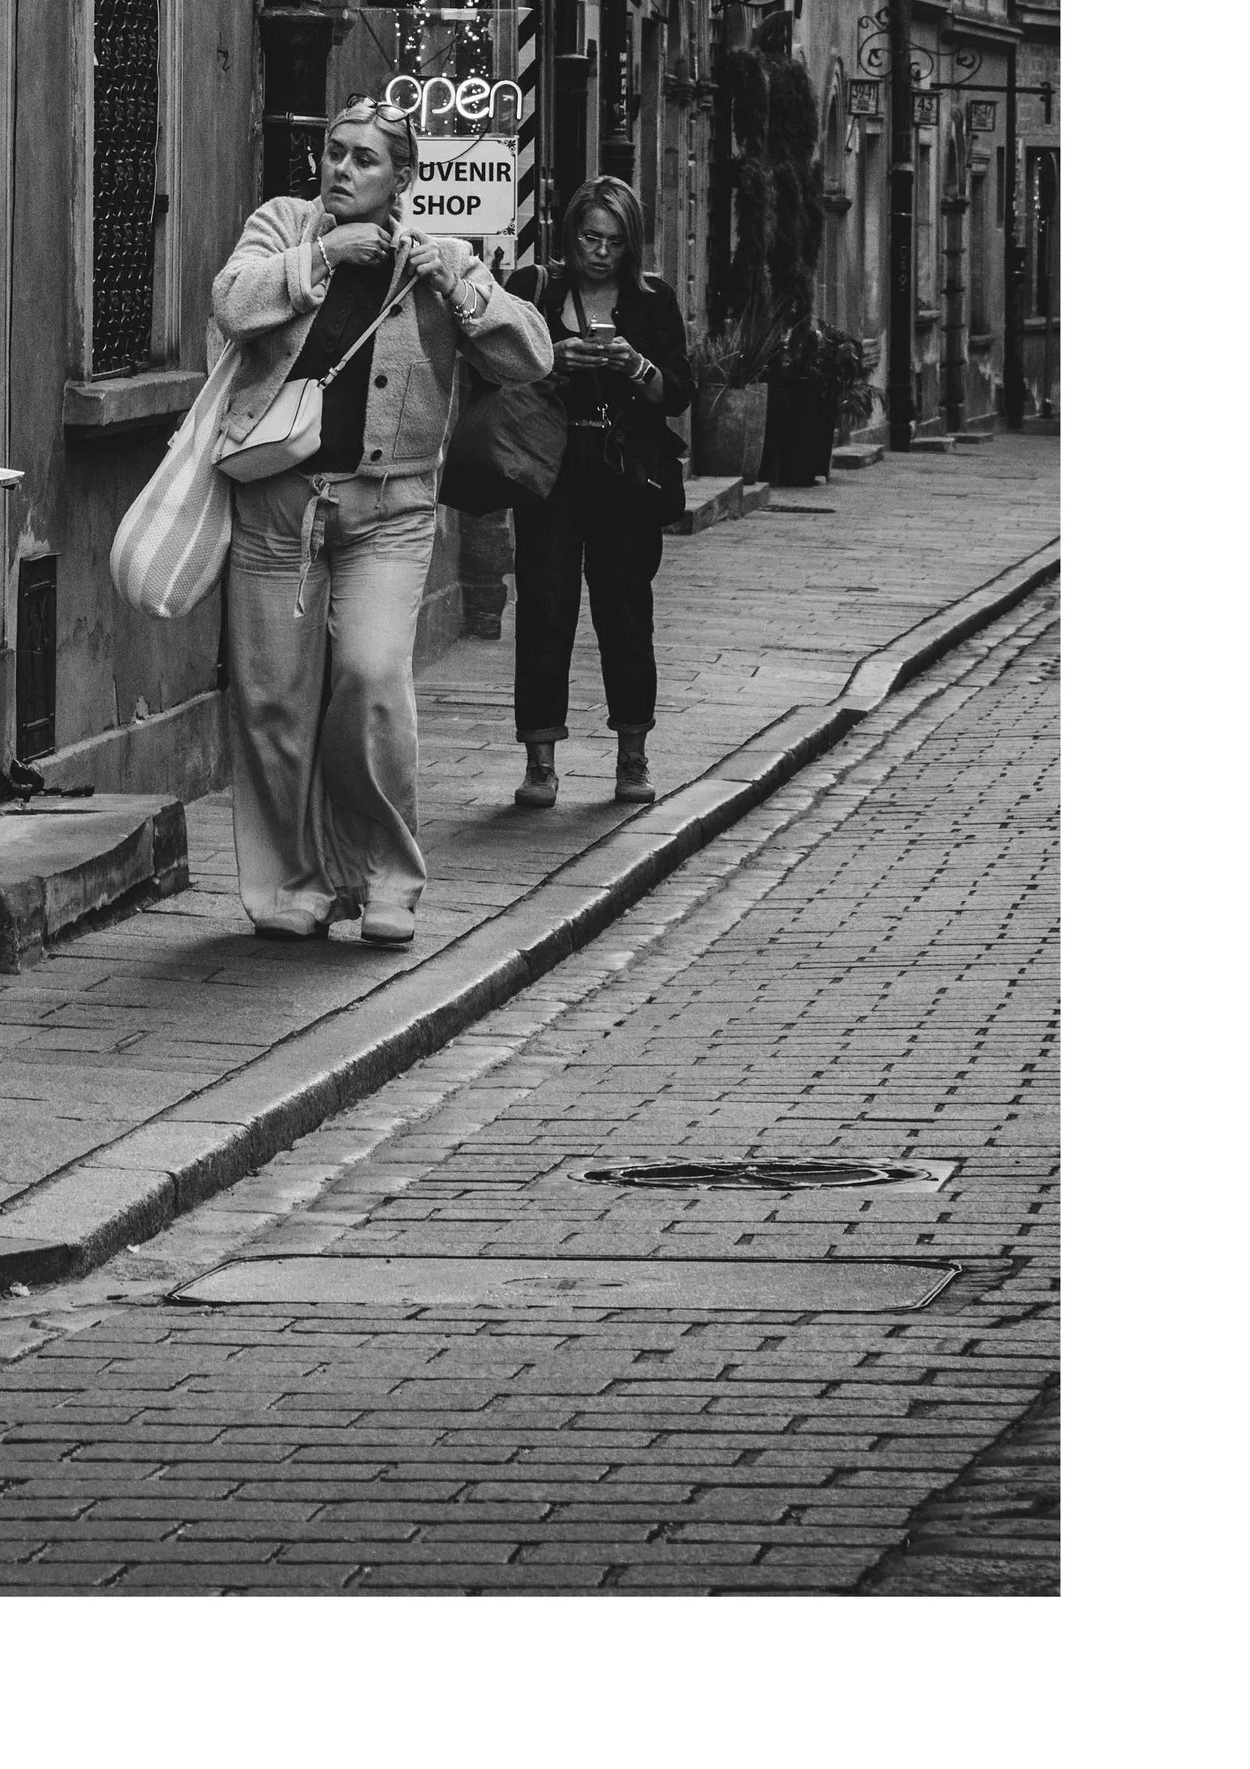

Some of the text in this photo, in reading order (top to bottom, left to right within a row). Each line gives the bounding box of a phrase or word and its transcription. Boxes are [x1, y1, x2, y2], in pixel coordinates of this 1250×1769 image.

[386, 75, 523, 129] open
[418, 161, 512, 182] UVENIR
[412, 195, 482, 216] SHOP
